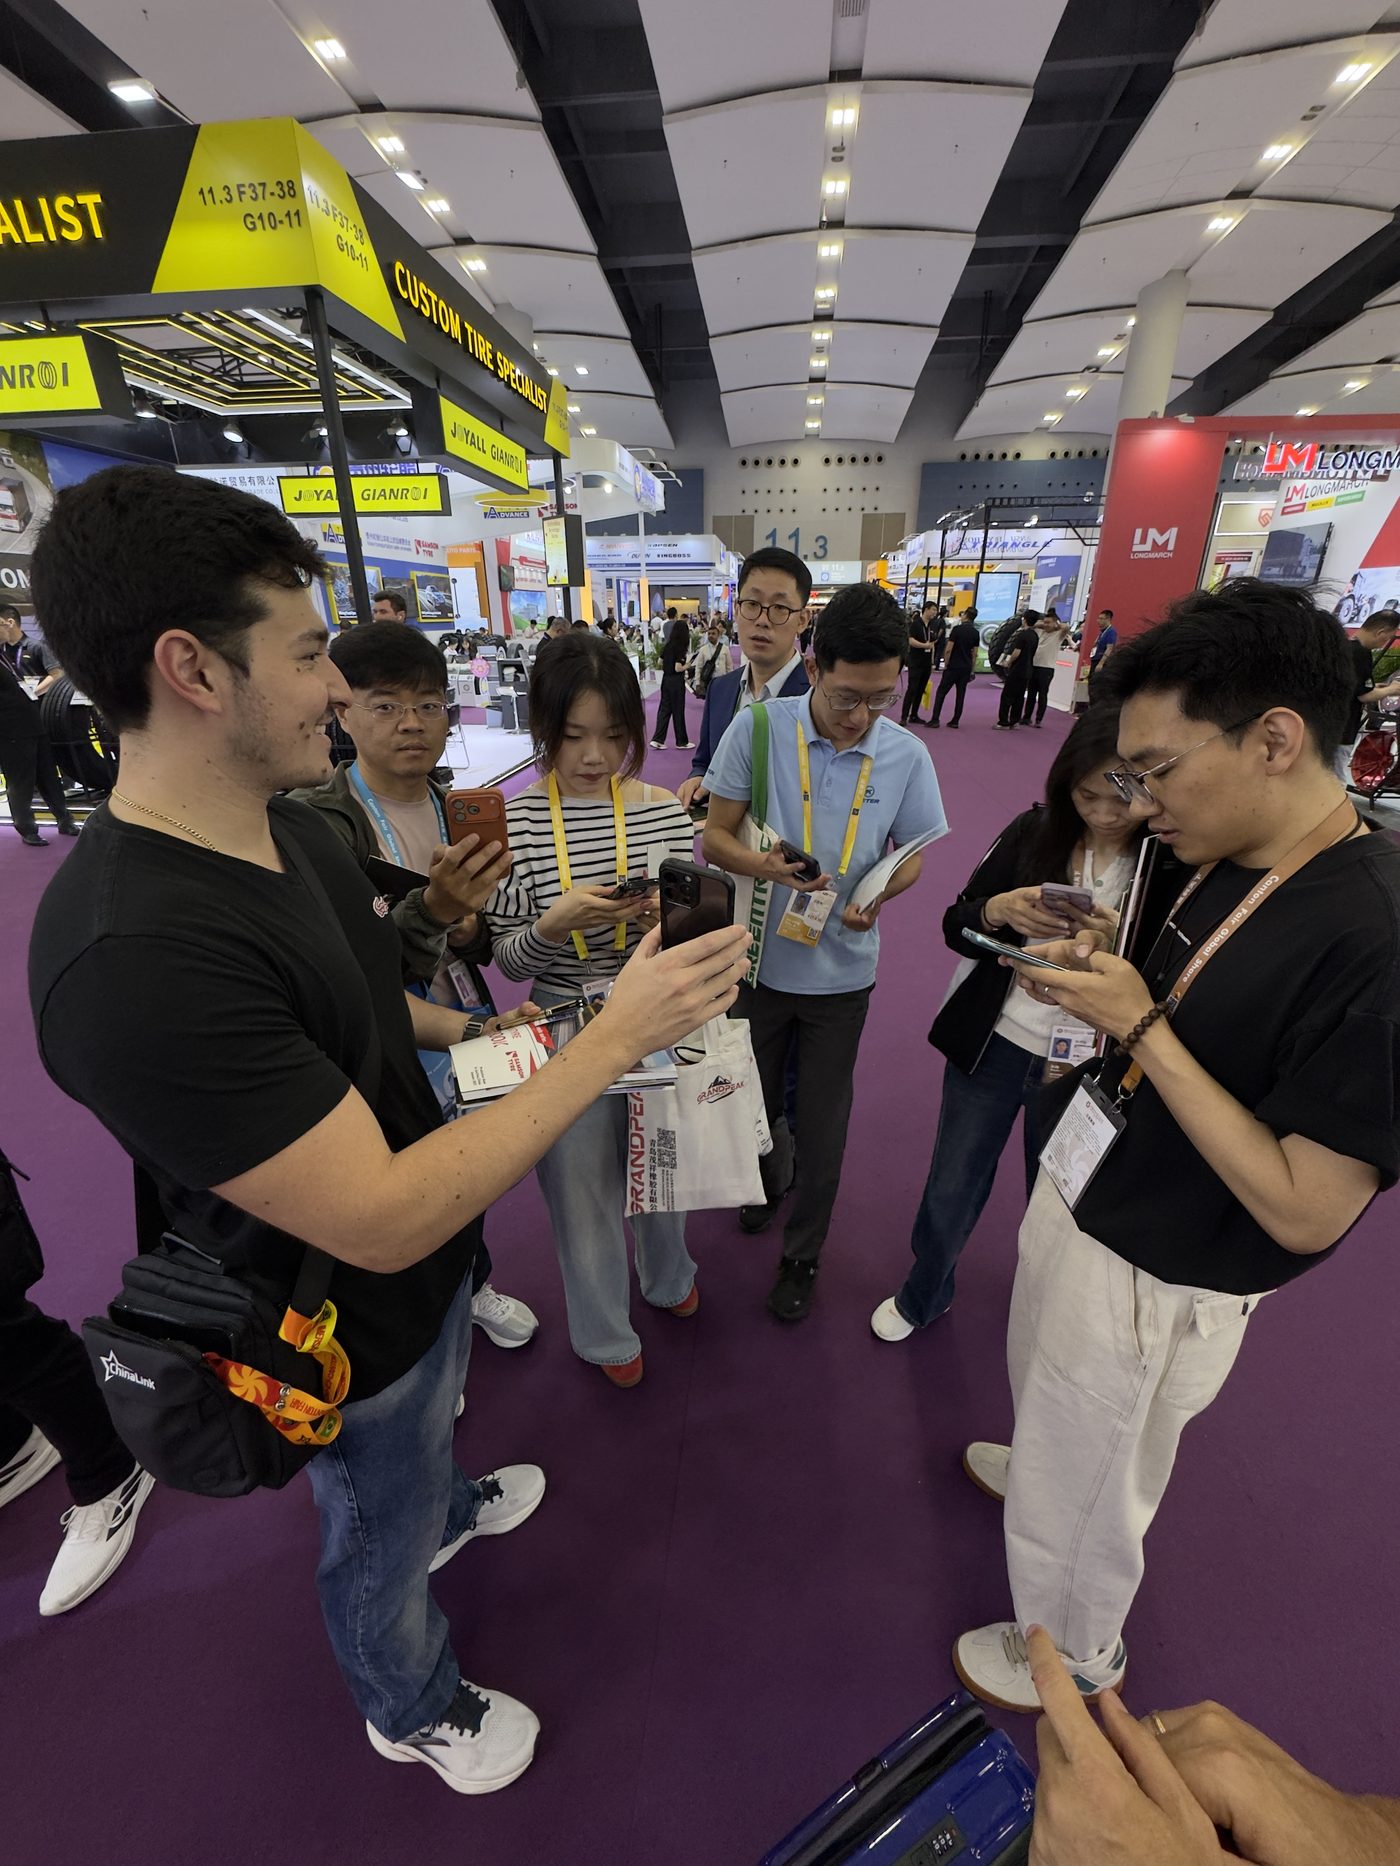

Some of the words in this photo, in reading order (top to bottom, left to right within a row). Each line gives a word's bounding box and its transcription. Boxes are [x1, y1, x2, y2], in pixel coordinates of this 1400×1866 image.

[198, 185, 234, 206] 11.3
[236, 179, 298, 203] F37-38
[243, 209, 303, 232] G10-11
[336, 233, 369, 272] G10-11
[394, 260, 462, 345] CUSTOM
[464, 320, 494, 371] TIRE
[496, 350, 548, 414] SPECIALIST
[294, 488, 338, 502] JOYA
[486, 506, 529, 519] ADVANCE
[765, 527, 828, 560] 11.3
[1130, 551, 1173, 560] LONGMARCH
[1248, 874, 1280, 905] Canton
[1230, 907, 1248, 926] Fair
[1202, 927, 1229, 957] Global
[1182, 957, 1203, 983] Share
[508, 1058, 517, 1072] TYRE
[513, 1057, 525, 1079] SAMSON
[696, 1080, 746, 1105] GRANDPEAK
[109, 1361, 156, 1391] ChinaLink
